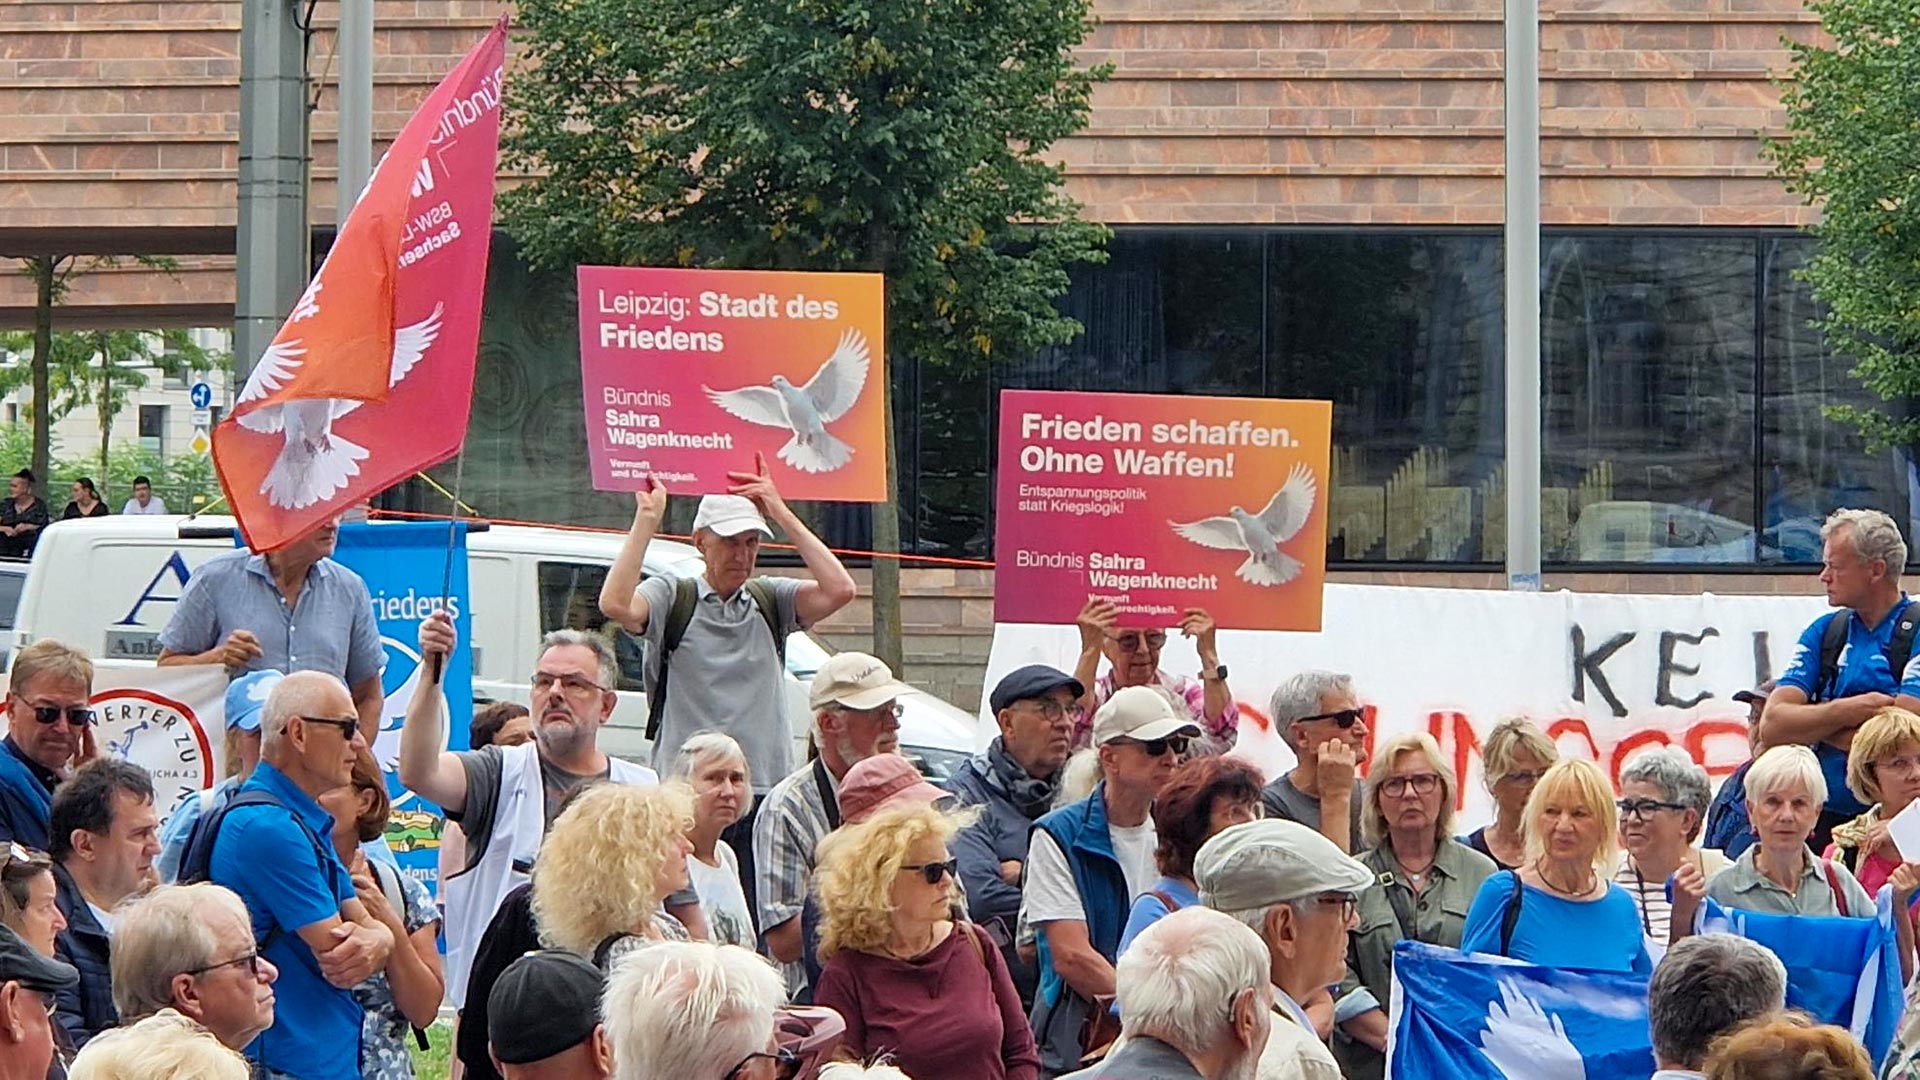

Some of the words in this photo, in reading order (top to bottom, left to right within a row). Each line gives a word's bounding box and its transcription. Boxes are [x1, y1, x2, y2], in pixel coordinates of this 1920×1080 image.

[598, 289, 691, 321] Leipzig:
[699, 291, 779, 318] Stadt
[786, 294, 839, 320] des
[600, 322, 724, 352] Friedens
[603, 386, 672, 406] Bündnis
[605, 408, 660, 427] Sahra
[607, 427, 733, 449] Wagenknecht
[1021, 413, 1141, 443] Frieden
[1152, 419, 1299, 448] schaffen.
[1020, 445, 1104, 474] Ohne
[1113, 448, 1235, 478] Waffen!
[631, 470, 698, 483] Gerchtigkeit.
[1019, 484, 1147, 501] Entspannungspolitik
[1018, 499, 1047, 513] statt
[1051, 500, 1125, 517] Kriegslogik!
[1016, 550, 1084, 569] Bündnis
[1089, 552, 1145, 570] Sahra
[112, 549, 191, 626] A
[1089, 570, 1218, 591] Wagenknecht
[174, 733, 197, 763] ZU
